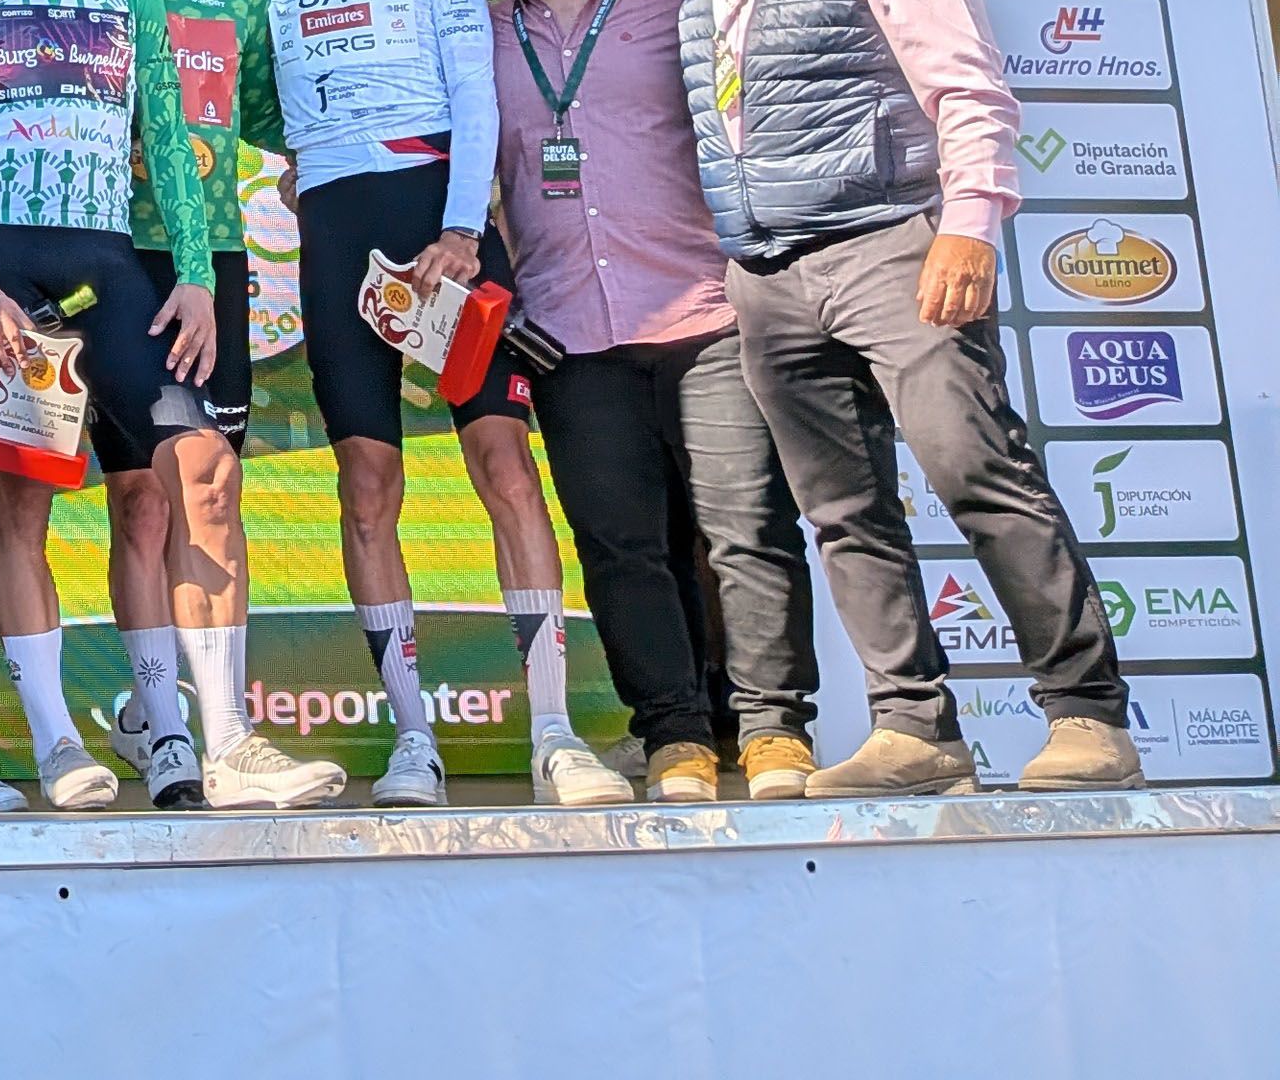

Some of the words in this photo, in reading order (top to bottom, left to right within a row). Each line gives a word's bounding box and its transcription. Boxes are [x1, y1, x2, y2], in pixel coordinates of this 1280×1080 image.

[2, 9, 33, 17] CORTIZO
[393, 3, 410, 12] IHC
[306, 12, 365, 30] Emirates
[439, 24, 484, 38] GSPORT
[304, 33, 375, 61] XRG
[69, 44, 128, 73] Burpellet
[174, 48, 225, 73] fidis
[1002, 54, 1093, 76] Navarro
[1097, 56, 1162, 77] Hnos.
[60, 84, 86, 95] BH
[7, 114, 115, 152] Andalucía
[543, 153, 560, 161] DEL
[560, 153, 579, 161] SOL
[550, 145, 575, 154] RUTA
[1073, 141, 1168, 161] Diputación
[1075, 160, 1098, 176] de
[1100, 161, 1177, 176] Granada
[1057, 253, 1163, 276] Gourmet
[1095, 278, 1132, 288] Latino
[1078, 340, 1169, 364] AQUA
[1083, 366, 1168, 386] DEUS
[1117, 487, 1191, 502] DIPUTACIÓN
[1119, 506, 1135, 516] DE
[1138, 504, 1169, 517] JAÉN
[1145, 587, 1238, 614] EMA
[1148, 617, 1241, 628] COMPETICIÓN
[1189, 708, 1252, 723] MÁLAGA
[1187, 724, 1259, 738] COMPITE
